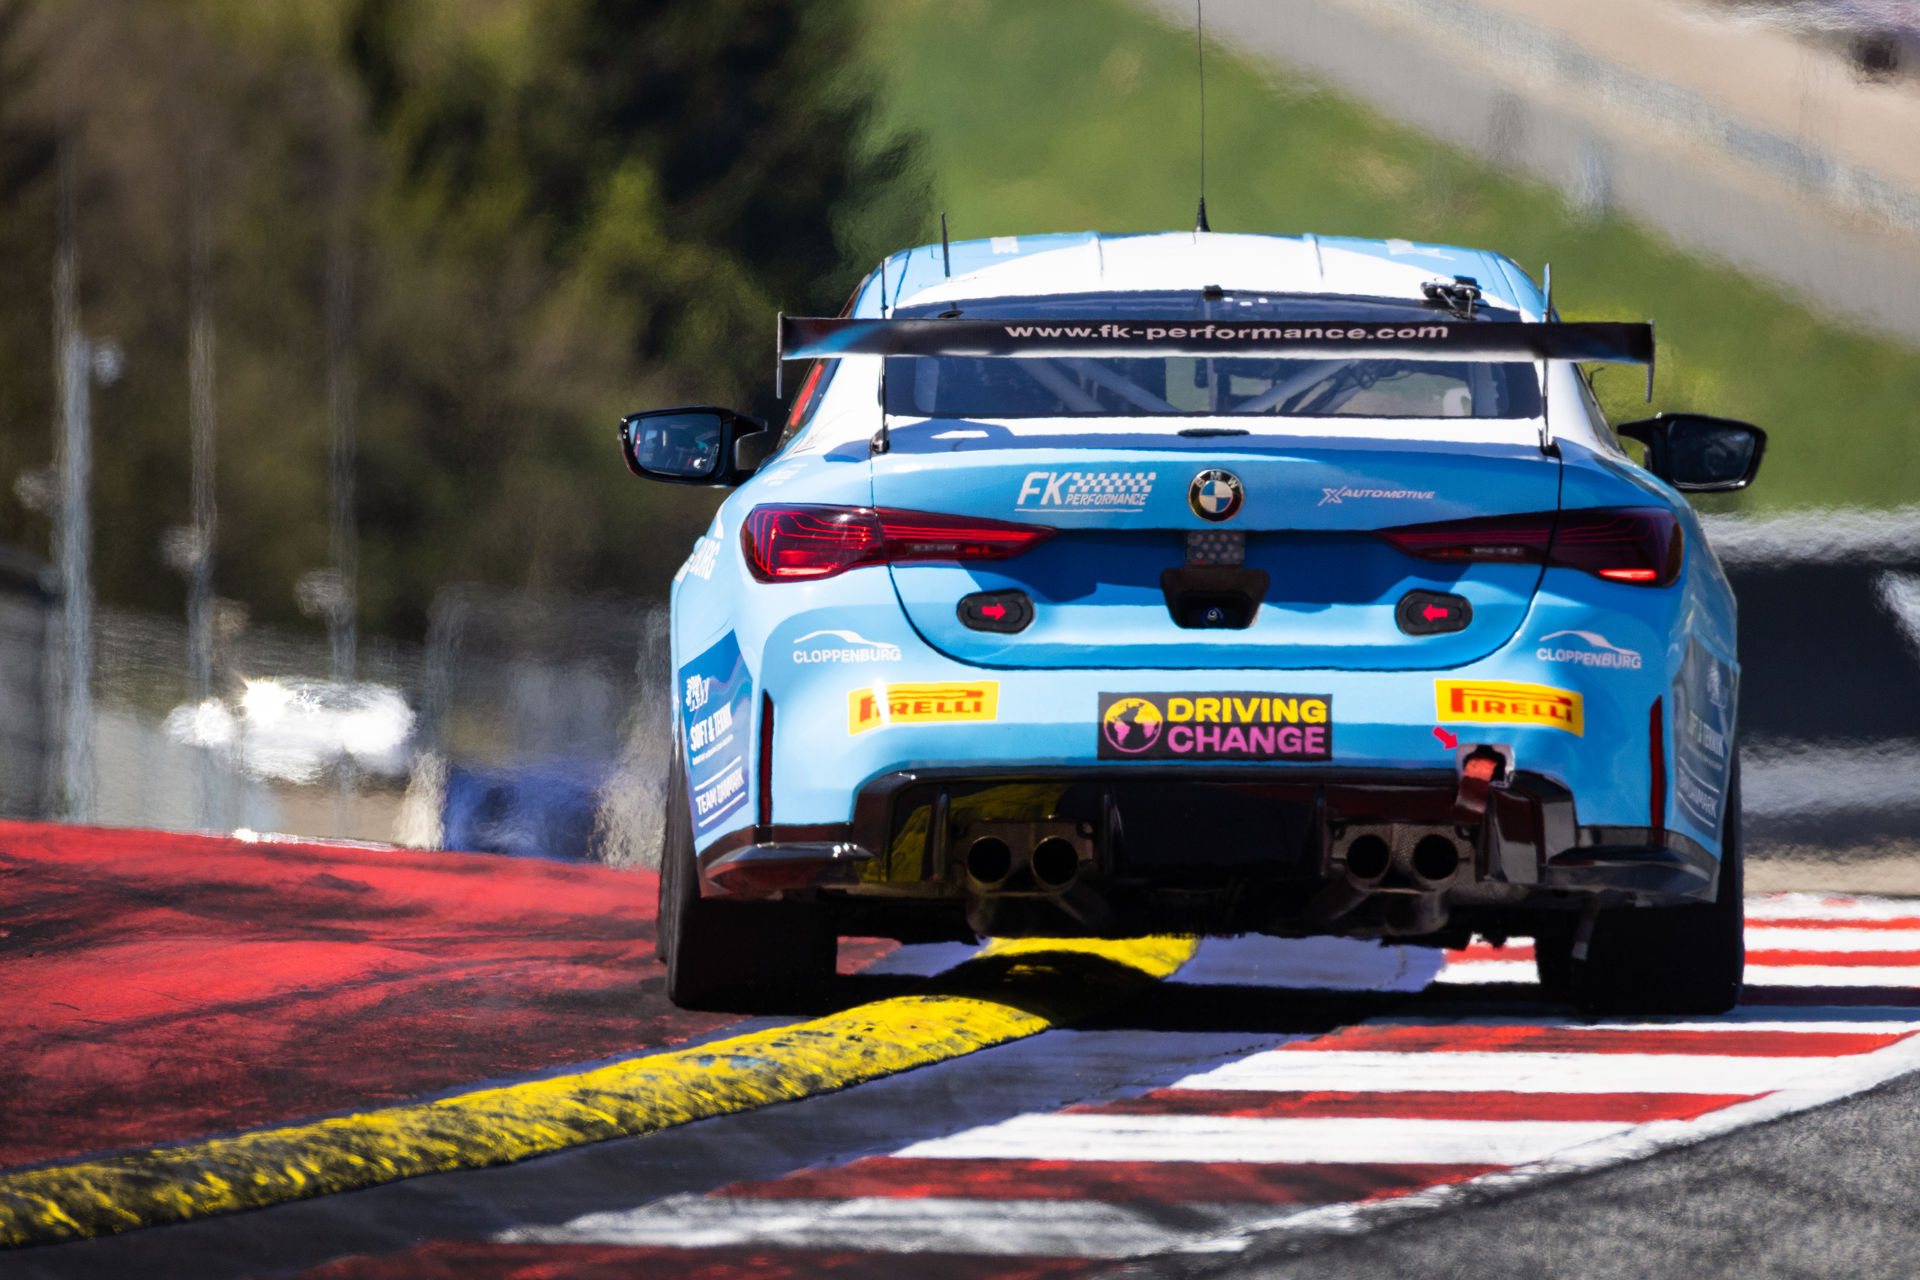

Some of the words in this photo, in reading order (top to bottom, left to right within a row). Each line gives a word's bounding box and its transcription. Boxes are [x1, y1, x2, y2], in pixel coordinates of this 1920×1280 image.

[1004, 323, 1450, 341] www.fk-performance.com
[1017, 472, 1073, 505] FK
[1065, 493, 1149, 506] PERFORMANCE
[793, 648, 902, 664] CLOPPENBURG
[1536, 647, 1642, 669] CLOPPENBURG
[1167, 697, 1328, 724] DRIVING
[1450, 687, 1573, 723] PIRELLI
[1167, 725, 1326, 755] CHANGE
